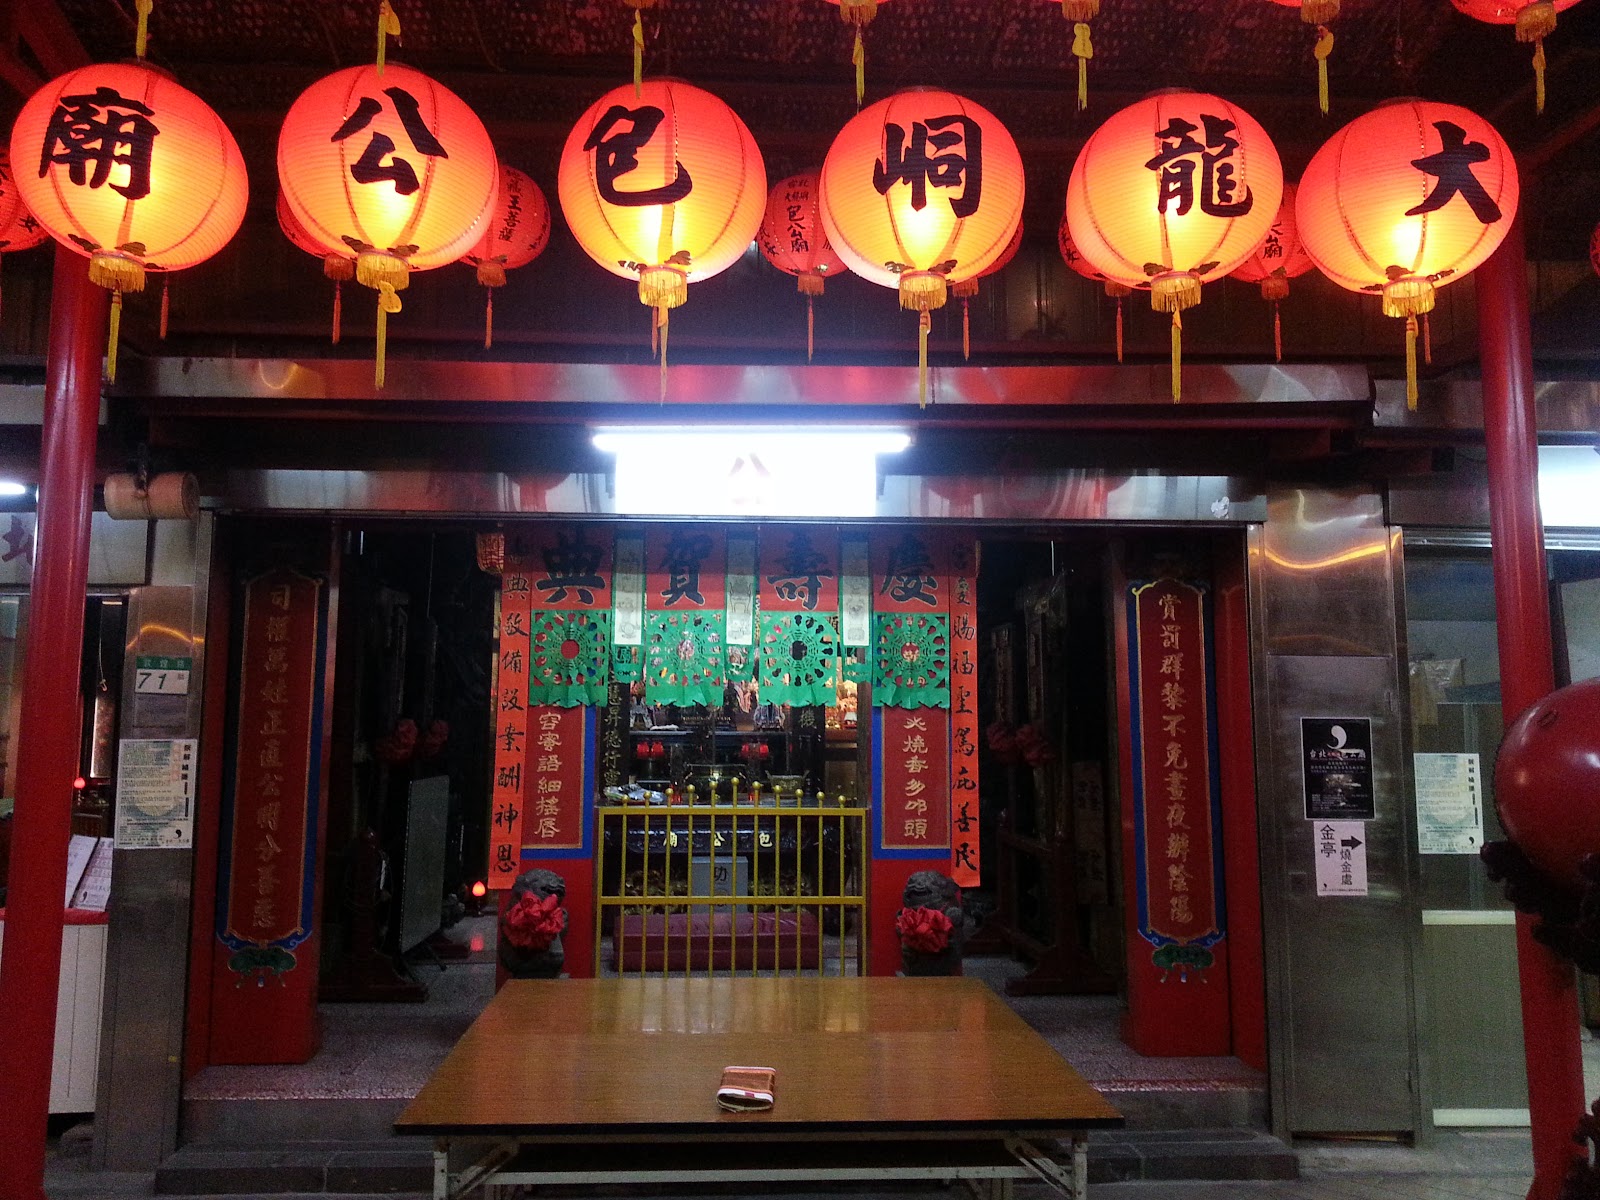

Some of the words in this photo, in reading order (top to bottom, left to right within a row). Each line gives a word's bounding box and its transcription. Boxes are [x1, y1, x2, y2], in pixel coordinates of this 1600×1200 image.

[39, 87, 161, 200] 廟
[331, 86, 448, 195] 公
[582, 105, 693, 206] 包
[873, 114, 982, 218] 峒
[1145, 114, 1253, 218] 龍
[1404, 120, 1503, 223] 大
[787, 204, 809, 253] 包公廟
[138, 672, 167, 690] 71
[1320, 823, 1337, 858] 金亭
